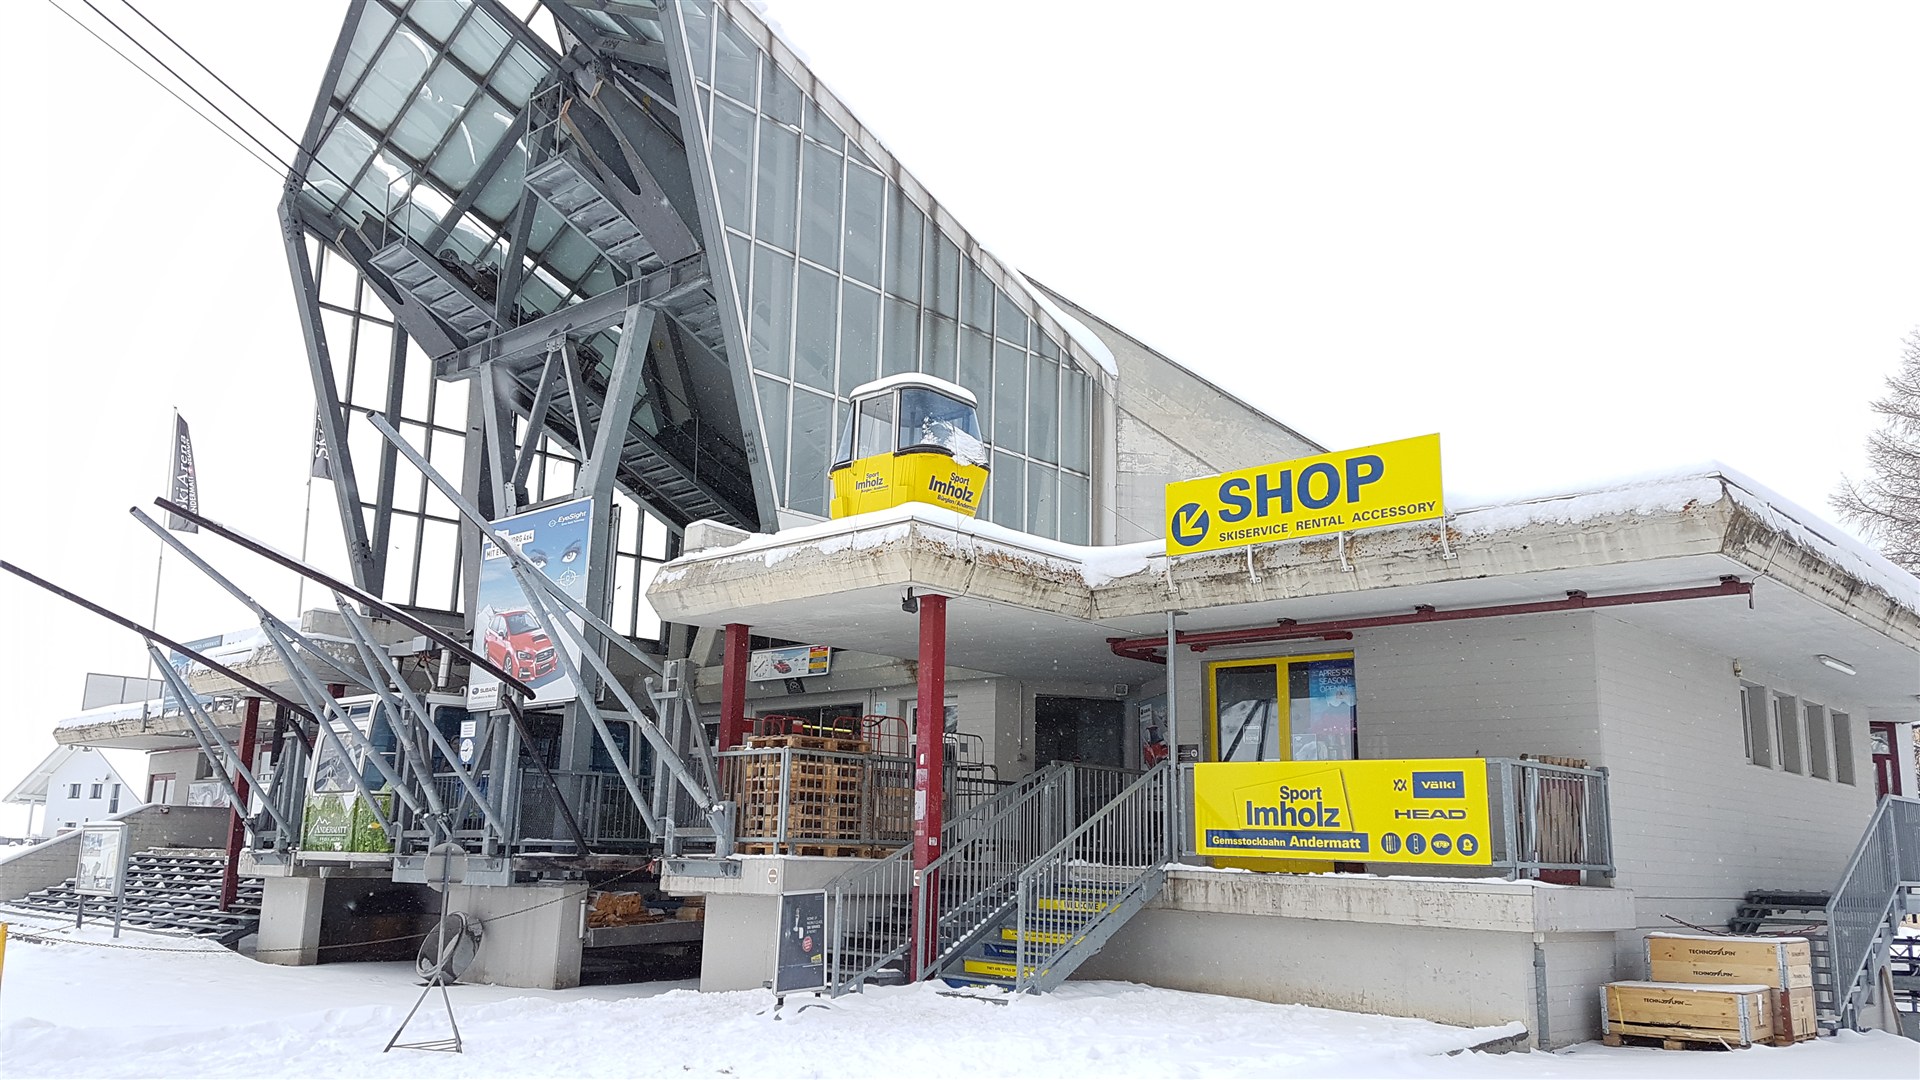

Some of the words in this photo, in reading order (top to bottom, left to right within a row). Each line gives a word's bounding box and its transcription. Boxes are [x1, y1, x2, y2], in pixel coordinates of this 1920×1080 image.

[866, 471, 880, 479] Sport
[950, 472, 970, 486] Sport
[855, 476, 884, 491] Imholz
[928, 475, 974, 503] Imholz
[1218, 454, 1385, 523] SHOP
[188, 476, 198, 515] NDERMATT
[557, 511, 587, 523] EyeSight
[1219, 523, 1289, 542] SKISERVICE
[1296, 515, 1345, 531] RENTAL
[1352, 501, 1437, 523] ACCESSORY
[1319, 677, 1348, 685] SEASON
[1421, 780, 1456, 790] Völkl
[1279, 785, 1323, 804] Sport
[1246, 800, 1341, 828] Imholz
[1394, 809, 1467, 820] HEAD
[1212, 835, 1286, 847] Gemsstockbahn
[1289, 835, 1361, 849] Andermatt
